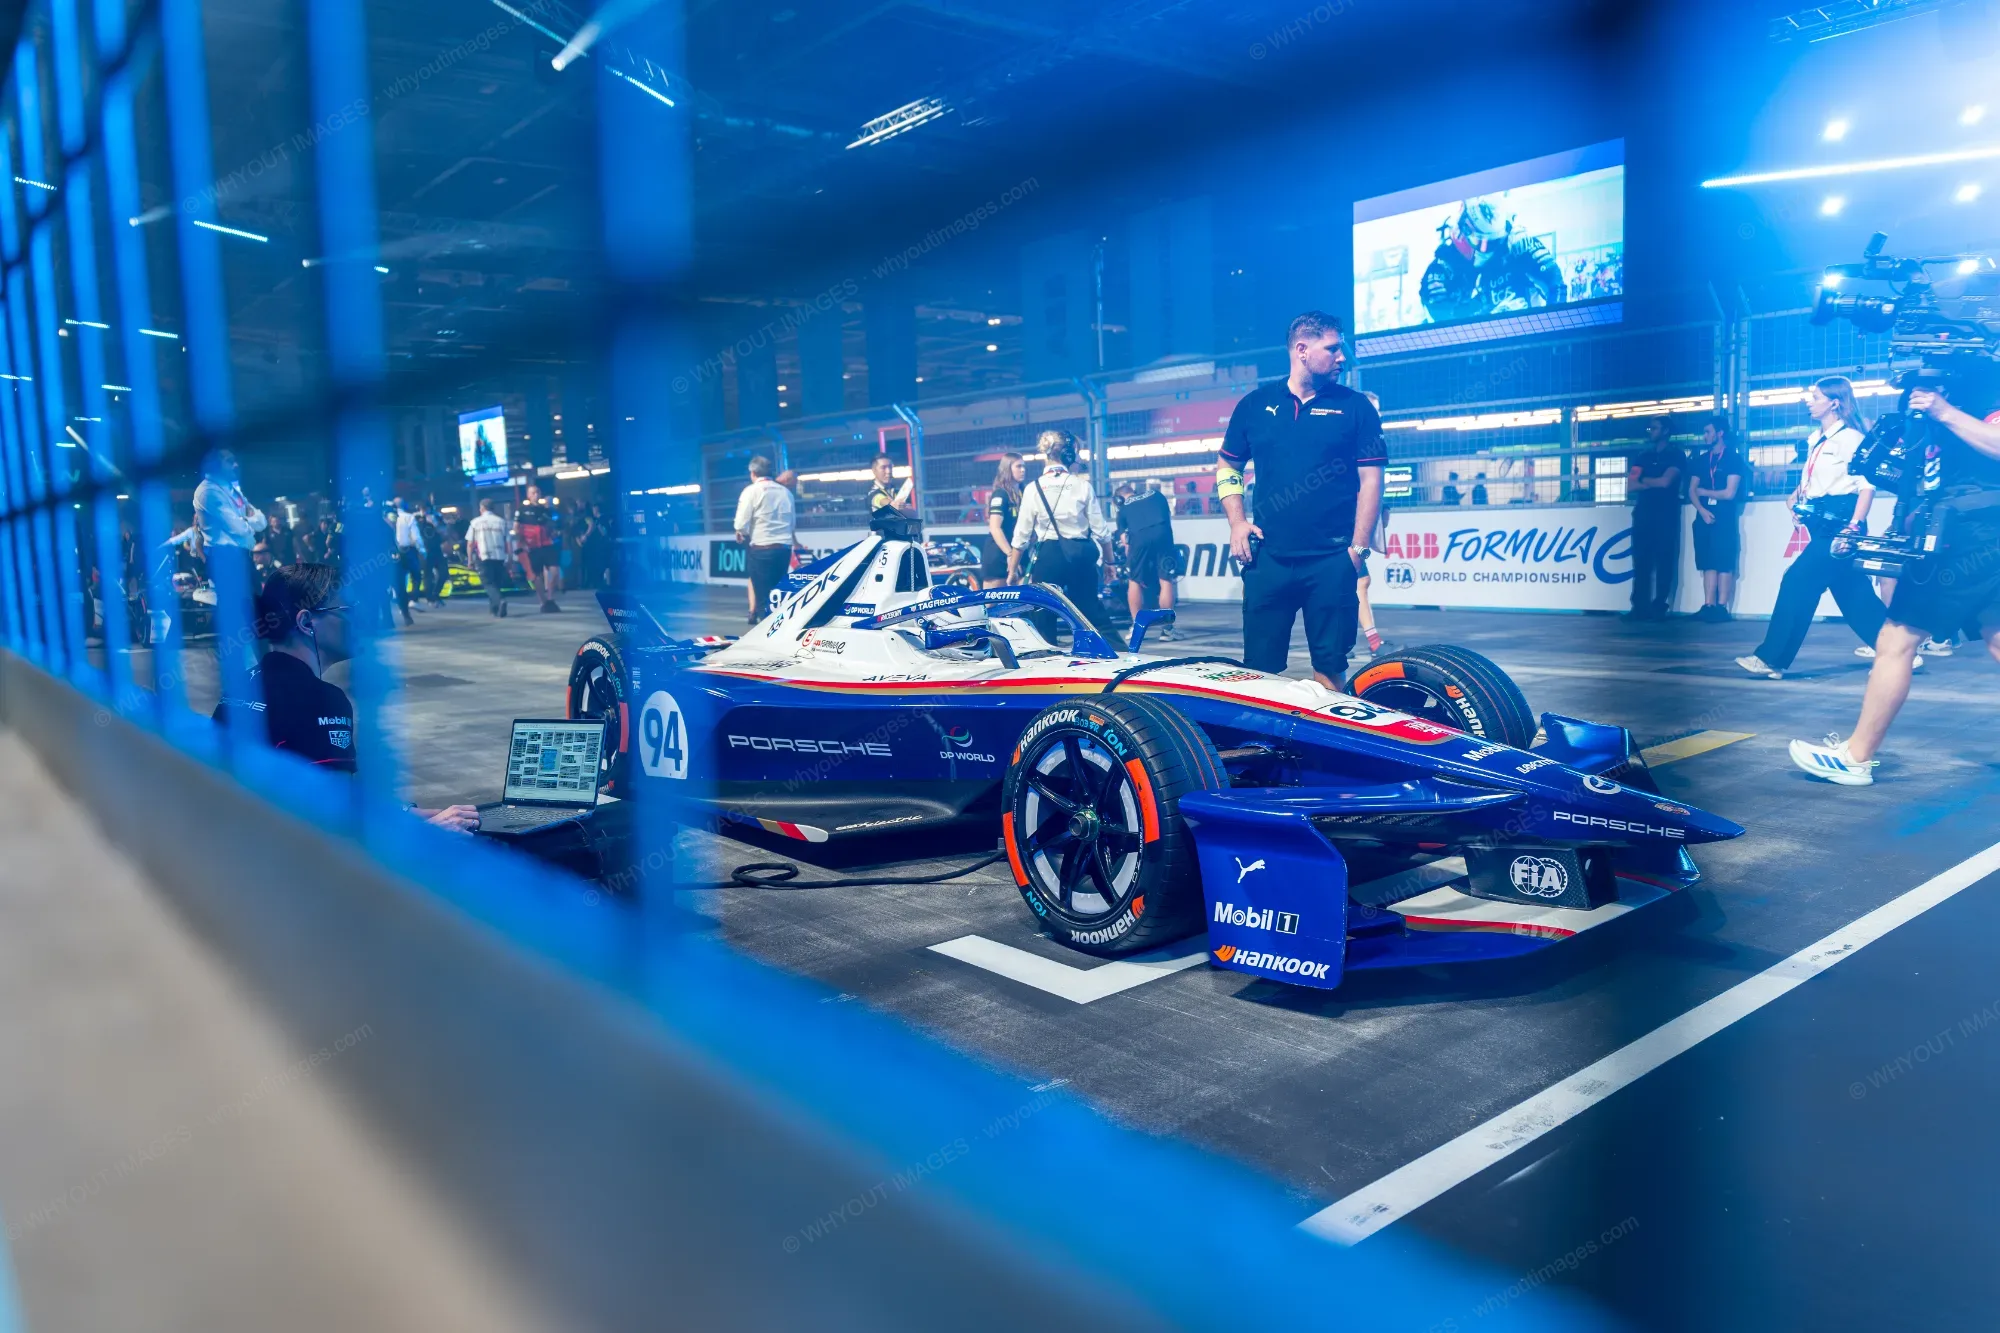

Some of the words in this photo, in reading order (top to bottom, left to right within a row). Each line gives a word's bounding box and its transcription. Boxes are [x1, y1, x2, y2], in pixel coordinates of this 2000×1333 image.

[1385, 533, 1440, 559] ABB
[1443, 526, 1599, 564] FORMULA
[1420, 572, 1467, 582] WORLD
[1473, 572, 1587, 584] CHAMPIONSHIP
[985, 591, 1020, 600] LOCTITE
[643, 707, 683, 772] 94
[728, 734, 893, 757] PORSCHE
[940, 751, 954, 759] DP
[956, 752, 996, 763] WORLD
[1553, 810, 1686, 839] PORSCHE
[1213, 901, 1274, 931] Mobil
